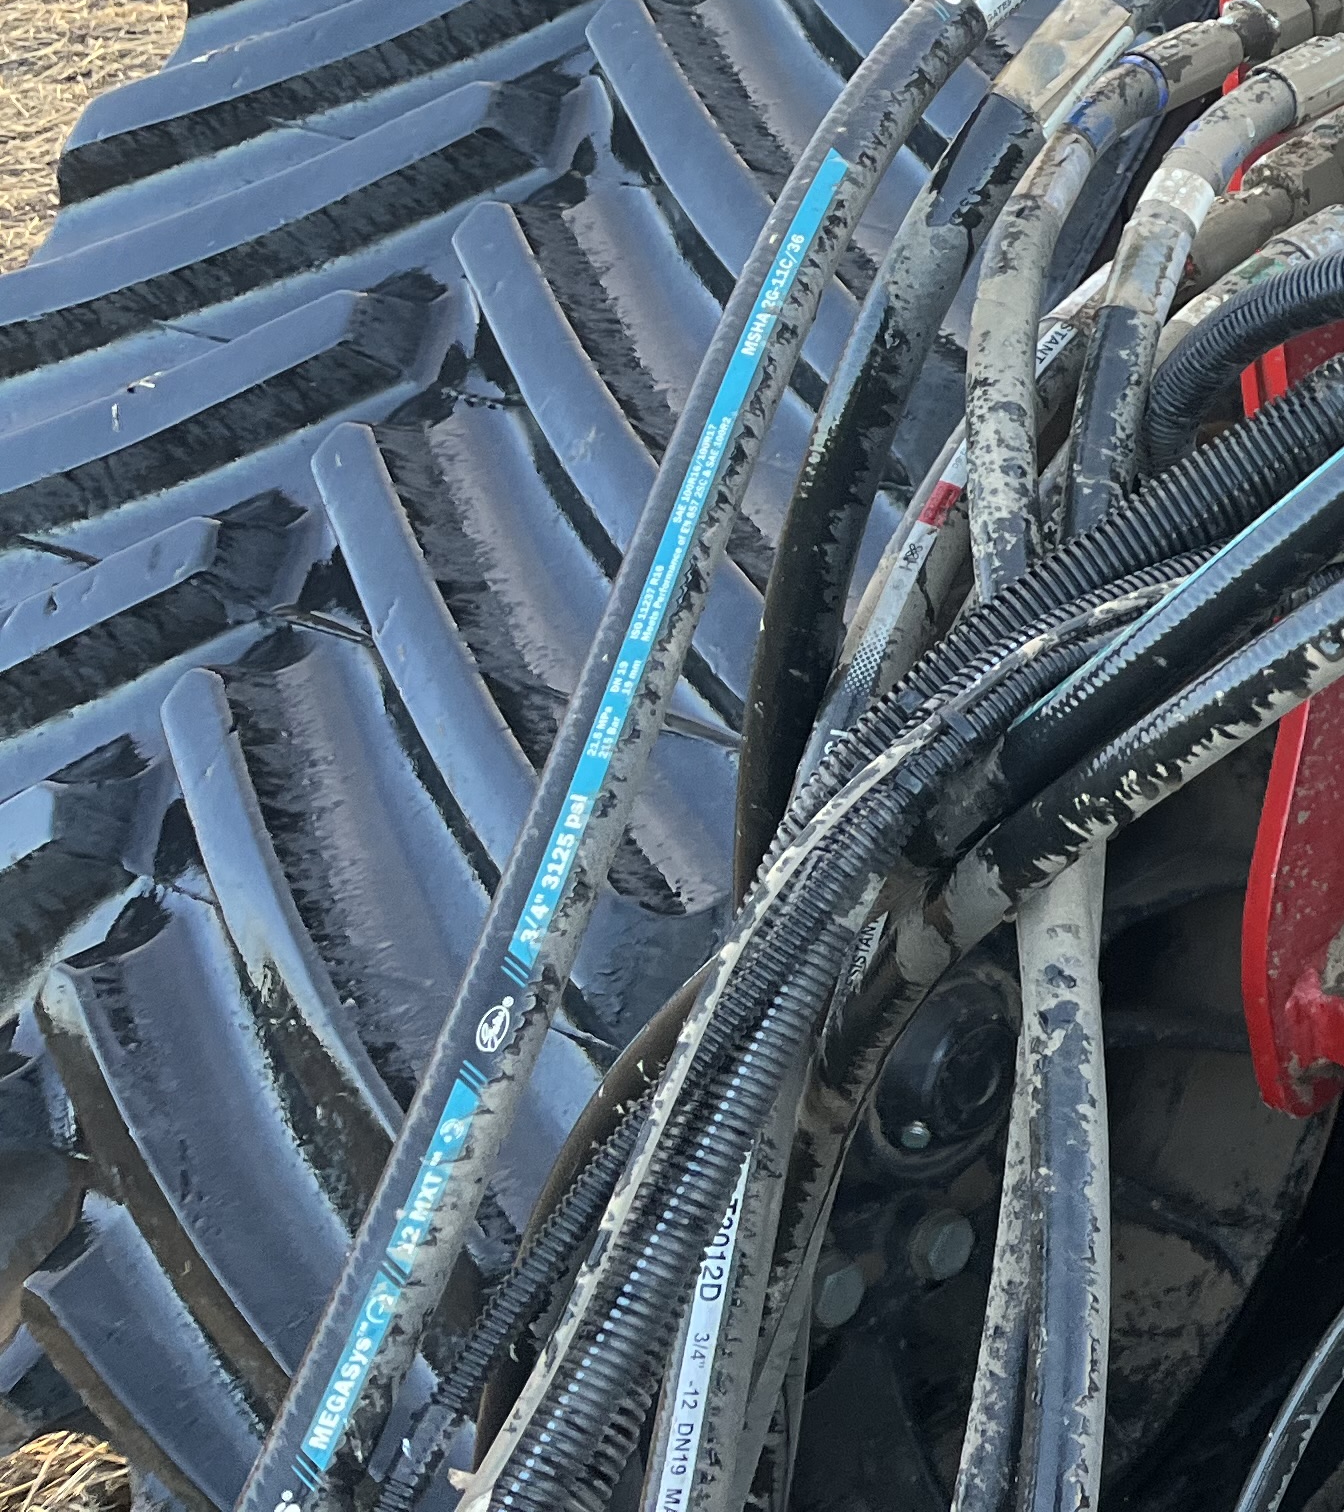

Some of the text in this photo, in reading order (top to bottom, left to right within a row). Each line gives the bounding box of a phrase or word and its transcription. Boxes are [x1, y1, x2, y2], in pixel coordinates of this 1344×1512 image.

[740, 309, 771, 357] MSHA
[672, 502, 687, 525] SAE
[640, 608, 660, 642] Meets
[652, 546, 683, 609] Performance
[676, 534, 686, 546] of
[704, 447, 719, 468] SAE
[629, 620, 643, 640] ISO
[609, 675, 623, 694] DN
[539, 829, 577, 892] 3125
[669, 1420, 694, 1476] DN19
